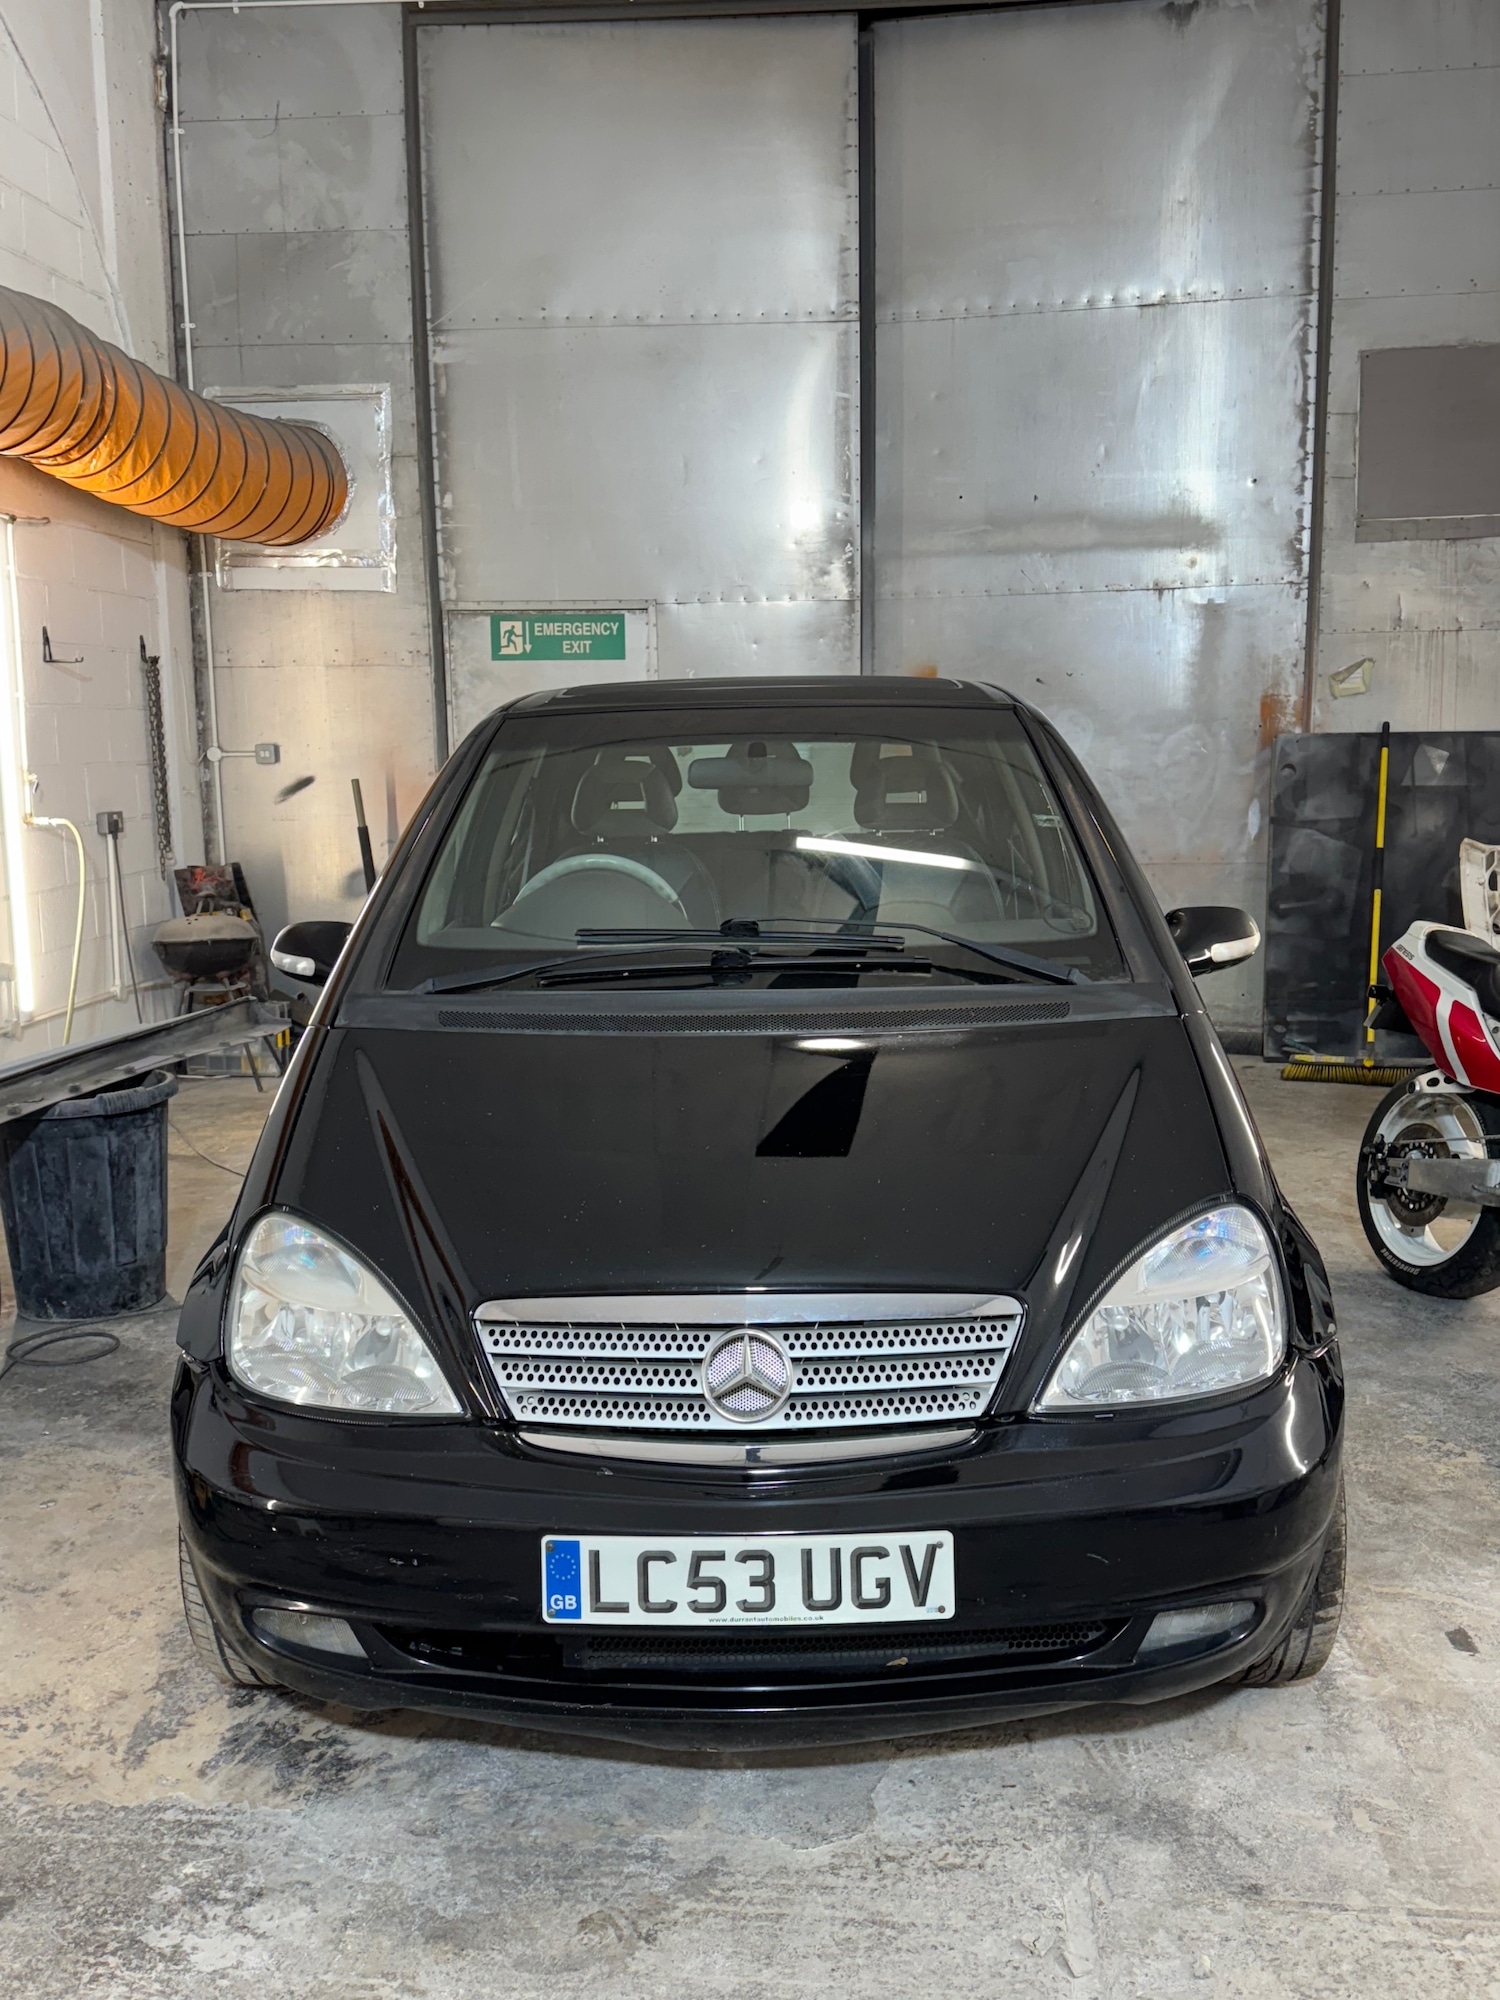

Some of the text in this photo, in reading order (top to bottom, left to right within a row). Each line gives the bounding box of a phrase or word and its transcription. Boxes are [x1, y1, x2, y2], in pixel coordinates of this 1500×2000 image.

[534, 622, 619, 636] EMERGENCY
[563, 640, 592, 654] EXIT
[588, 1544, 938, 1614] LC53 UGV
[550, 1594, 578, 1611] GB
[708, 1615, 824, 1623] www.durrantautomobiles.co.uk
